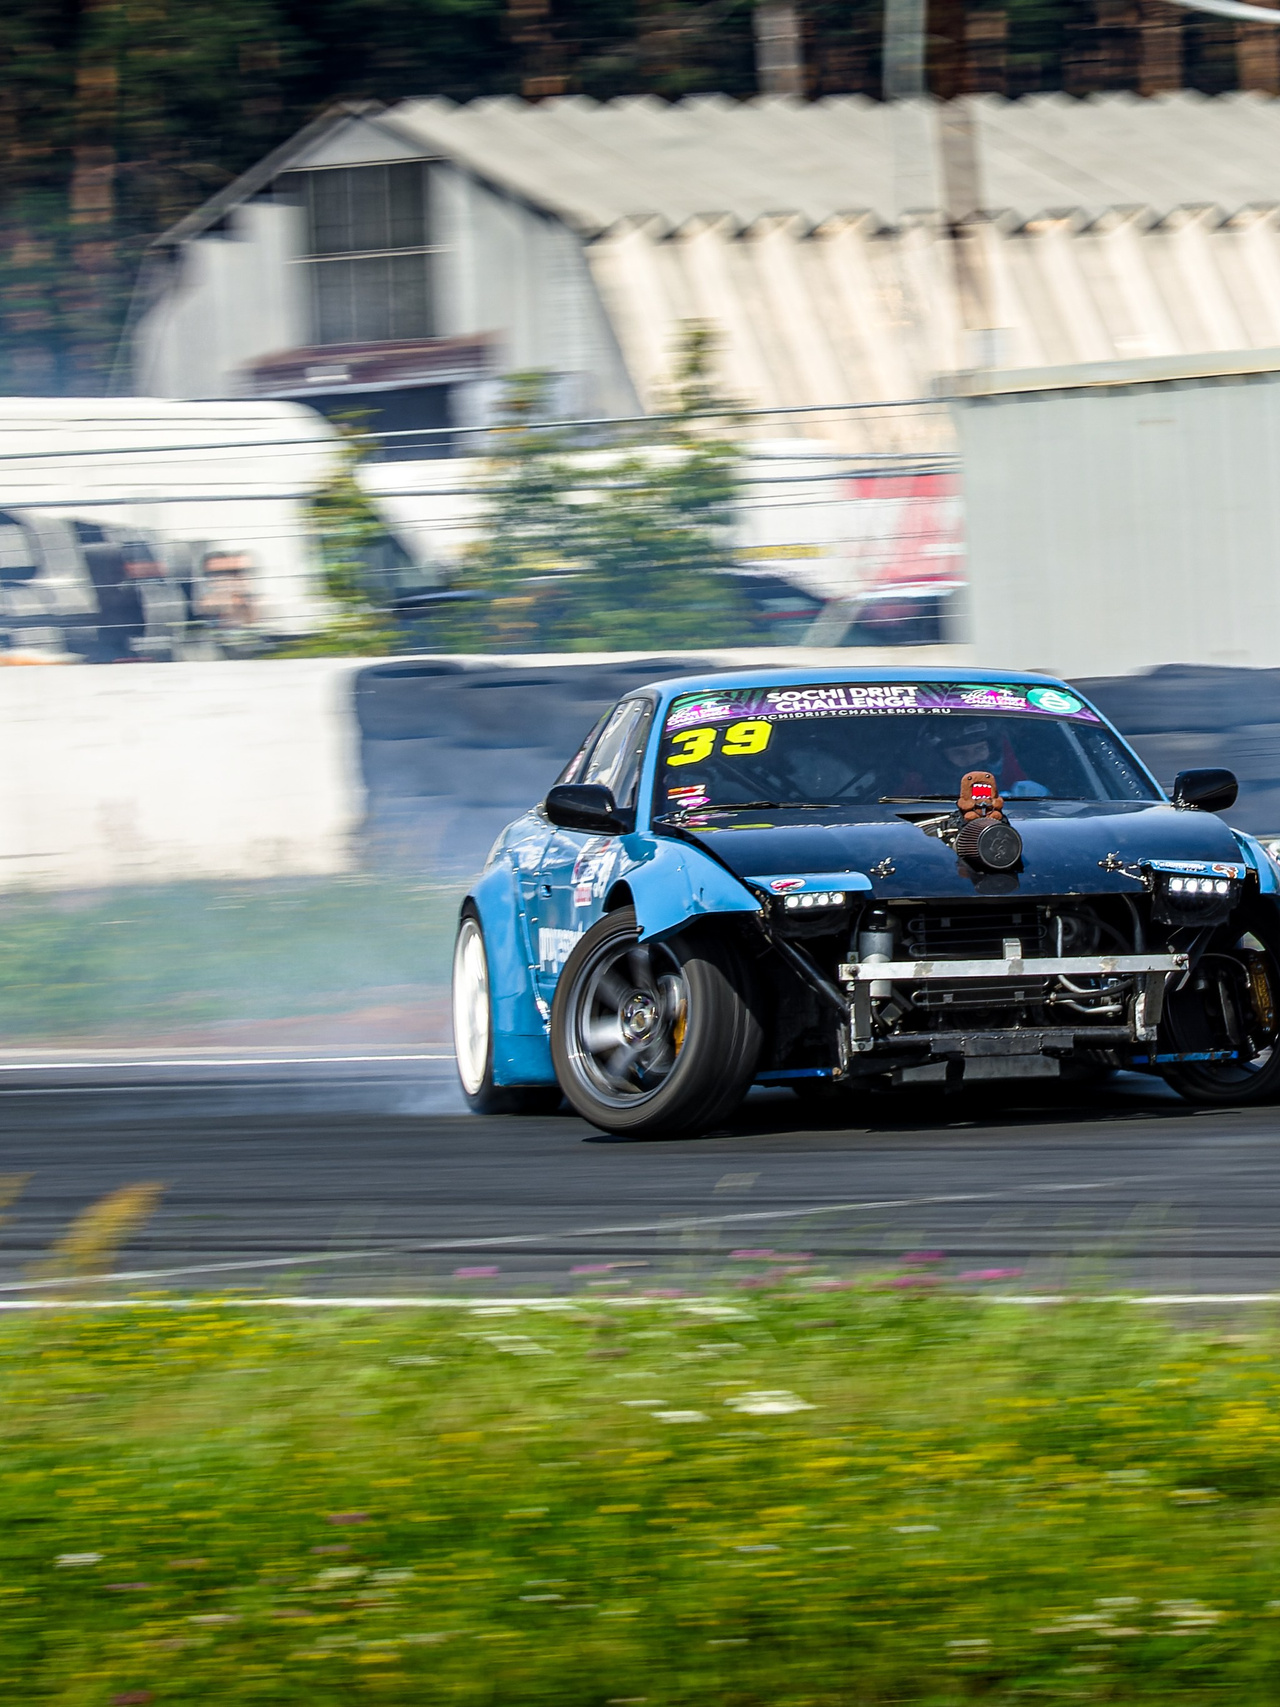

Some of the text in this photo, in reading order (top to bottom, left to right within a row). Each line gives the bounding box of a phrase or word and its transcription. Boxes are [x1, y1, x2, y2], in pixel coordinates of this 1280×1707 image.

[767, 686, 919, 703] SOCHI DRIFT
[775, 696, 919, 712] CHALLENGE
[666, 720, 773, 767] 39
